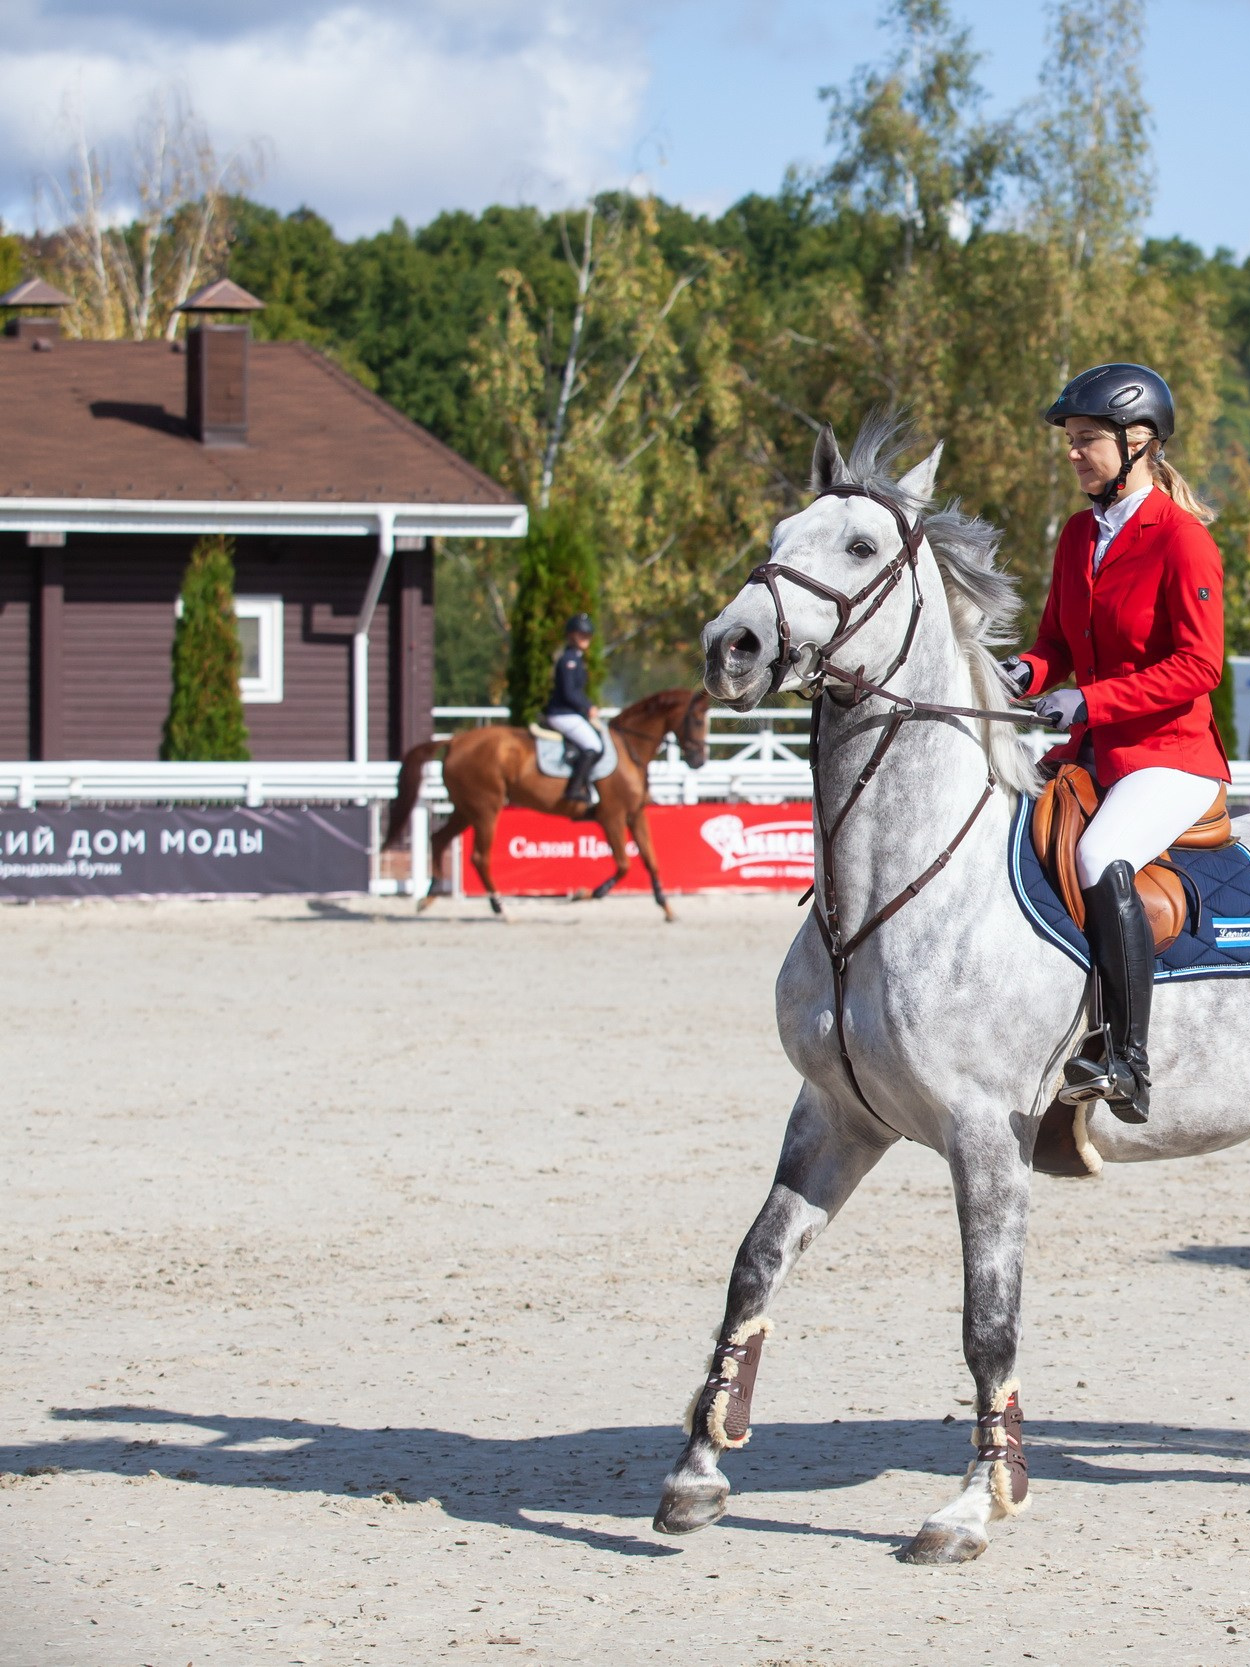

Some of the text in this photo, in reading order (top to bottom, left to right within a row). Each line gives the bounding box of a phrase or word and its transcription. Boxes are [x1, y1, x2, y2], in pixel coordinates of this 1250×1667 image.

[0, 825, 263, 858] ИЙ ДОМ МОДЫ
[509, 835, 568, 859] Салон
[77, 860, 122, 880] бутик
